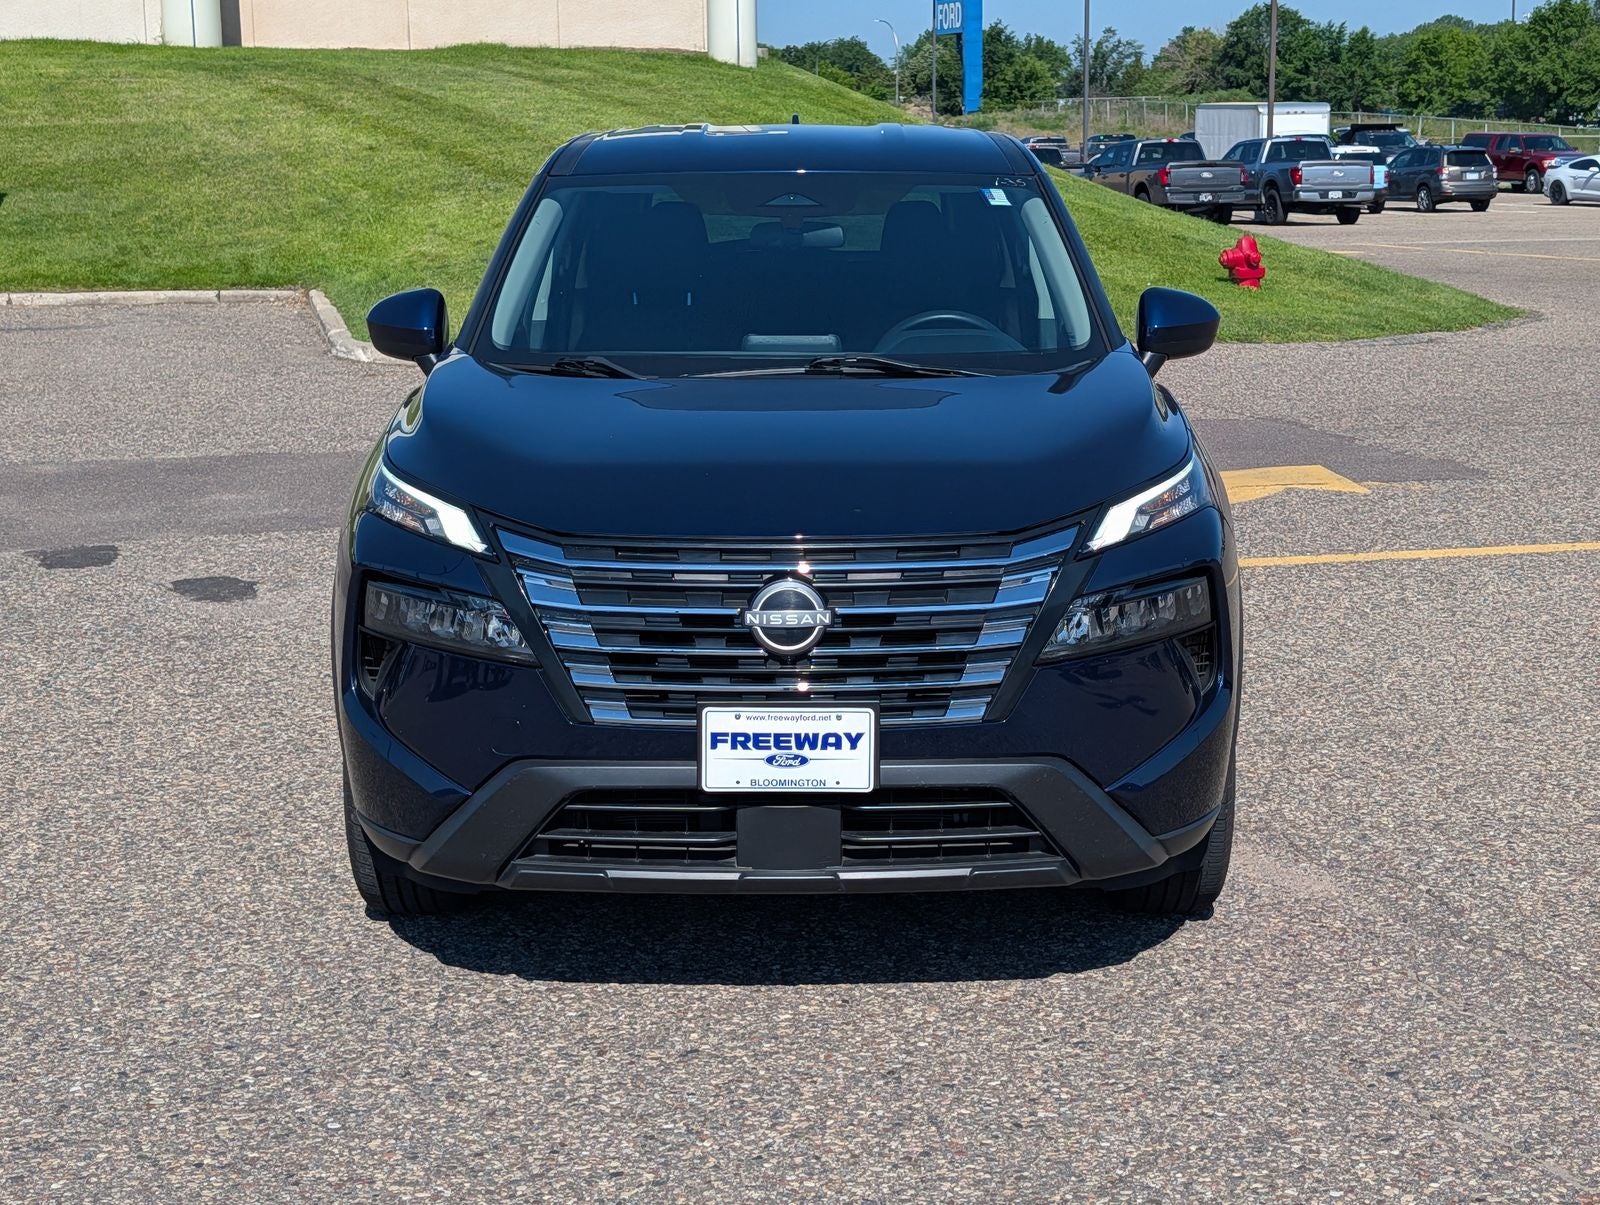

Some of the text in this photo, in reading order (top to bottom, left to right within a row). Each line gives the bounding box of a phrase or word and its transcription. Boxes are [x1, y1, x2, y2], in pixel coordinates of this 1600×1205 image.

[937, 2, 962, 29] FORD
[746, 613, 829, 625] NISSAN
[745, 714, 832, 723] www.freewayford.net
[710, 732, 866, 750] FREEWAY
[772, 753, 801, 767] Ford
[750, 779, 826, 787] BLOOMINGTON
